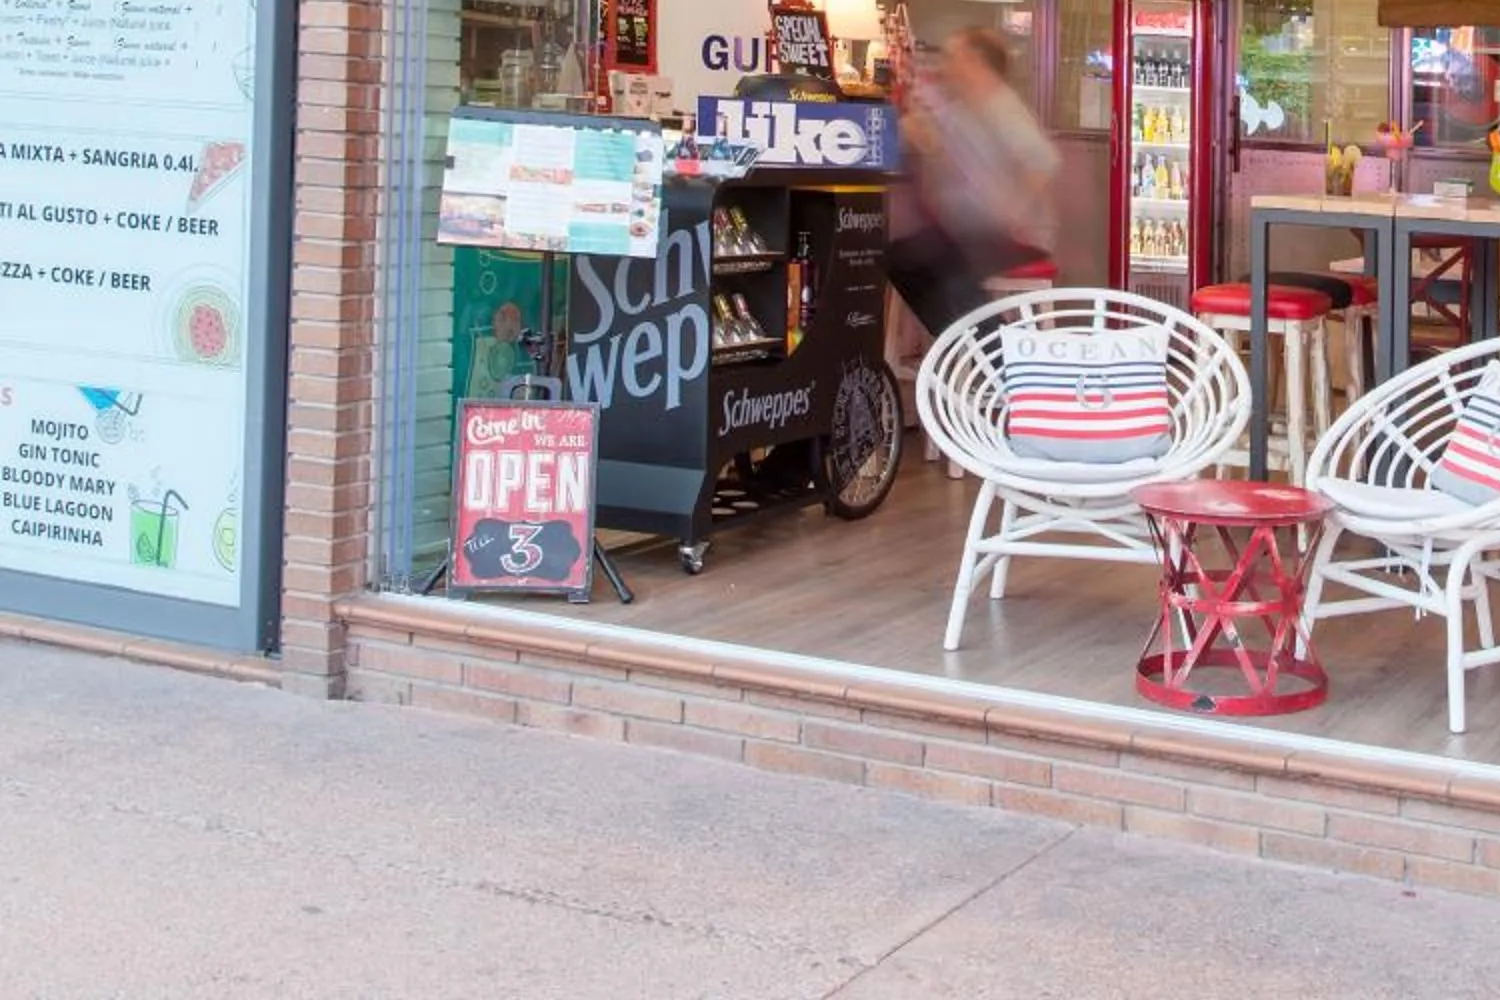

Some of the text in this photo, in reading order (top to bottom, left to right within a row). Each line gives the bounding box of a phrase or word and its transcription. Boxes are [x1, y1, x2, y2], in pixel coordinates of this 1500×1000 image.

[779, 37, 829, 67] SWEET
[11, 143, 64, 163] MIXTA
[83, 148, 158, 170] SANGRIA
[17, 205, 36, 221] AL
[43, 205, 97, 225] GUSTO
[117, 212, 160, 231] COKE
[178, 217, 219, 236] BEER
[51, 266, 94, 286] COKE
[111, 271, 151, 291] BEER
[1017, 336, 1158, 361] OCEAN
[718, 384, 812, 437] Schweppes
[31, 419, 89, 441] MOJITO
[467, 415, 519, 445] Come
[534, 434, 585, 448] WE ARE
[19, 443, 100, 468] GIN TONIC
[2, 466, 116, 496] BLOODY MARY
[466, 450, 589, 514] OPEN
[3, 491, 113, 522] BLUE LAGOON
[11, 519, 103, 547] CAIPIRINHA
[500, 524, 544, 573] 3
